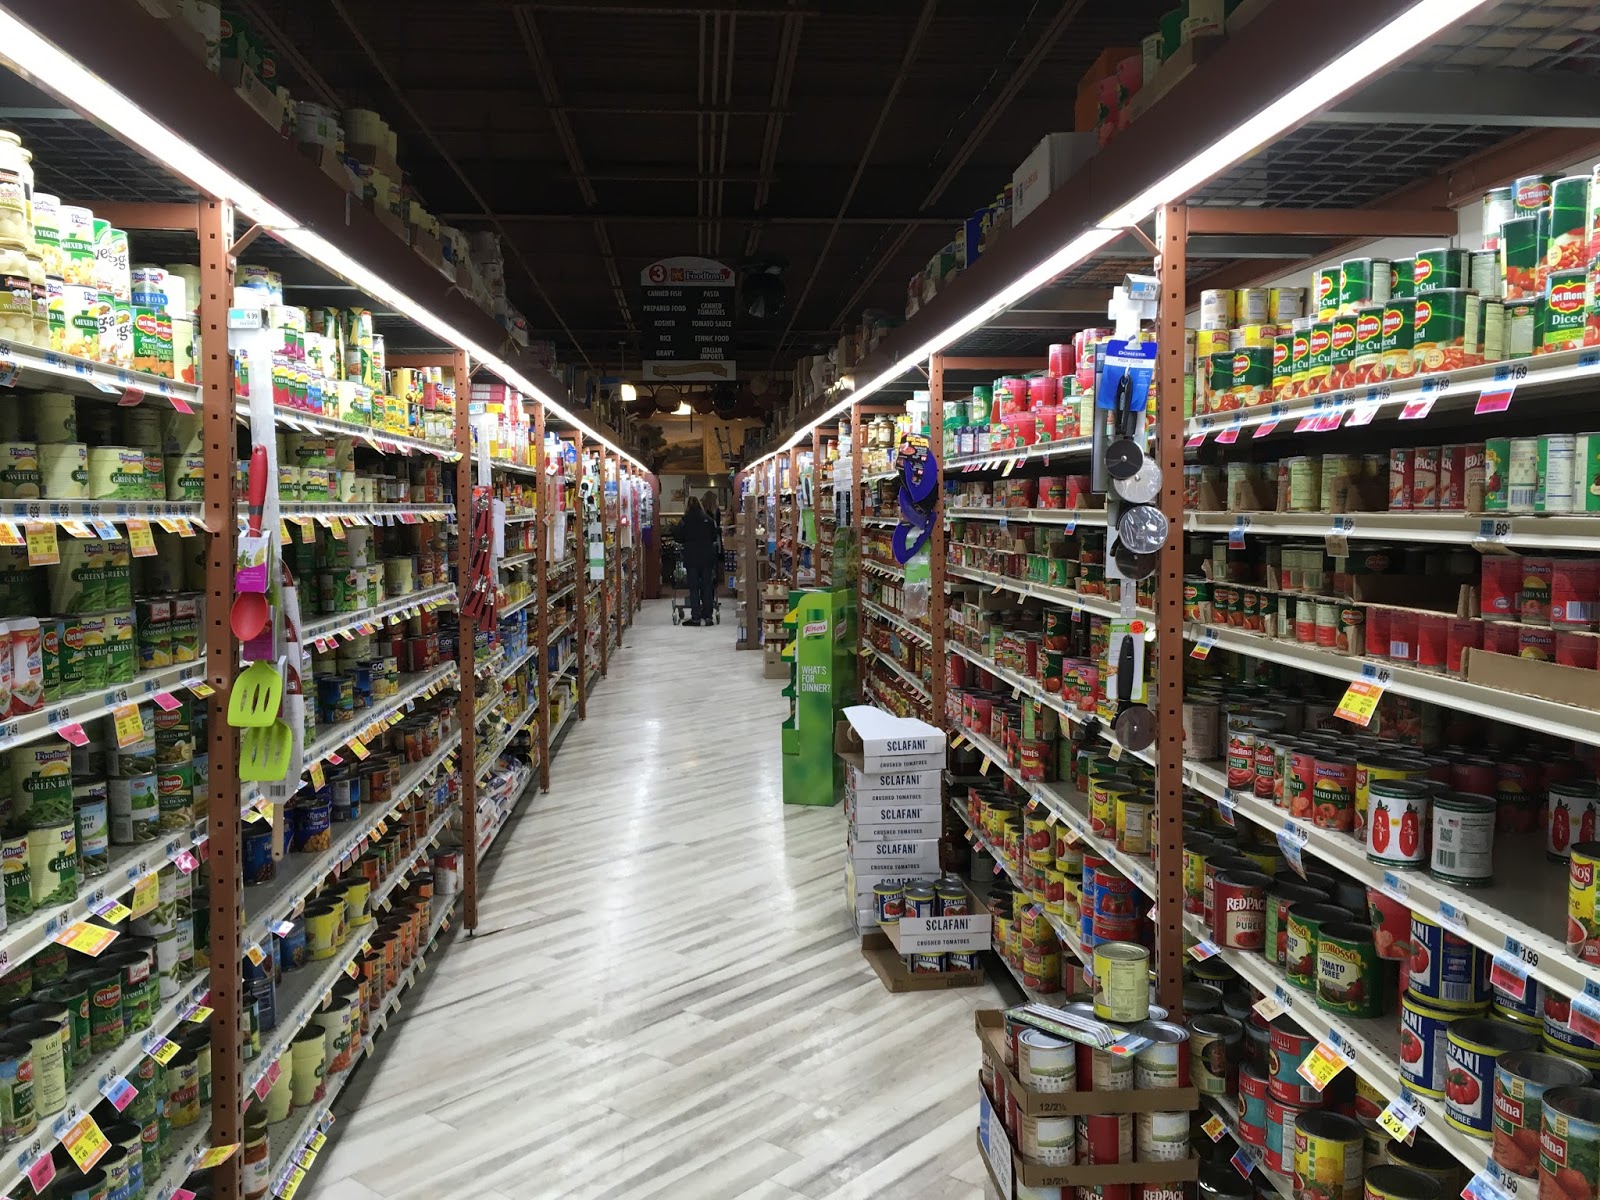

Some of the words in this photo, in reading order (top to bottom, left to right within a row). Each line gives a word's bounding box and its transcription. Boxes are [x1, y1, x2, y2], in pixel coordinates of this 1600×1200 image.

[652, 265, 664, 281] 3
[686, 269, 725, 280] Foodtown
[134, 295, 166, 303] ARROTS
[1552, 293, 1563, 303] Del
[74, 319, 93, 327] MIXED
[801, 666, 827, 675] WHAT'S
[801, 675, 815, 683] FOR
[801, 683, 831, 692] DINNER?
[887, 740, 926, 751] SCLAFANI
[1316, 767, 1345, 777] Foodtown
[880, 775, 920, 786] SCLAFANI
[28, 781, 55, 791] GREEN
[880, 808, 920, 820] SCLAFANI
[876, 844, 916, 855] SCLAFANI
[926, 919, 969, 931] SCLAFANI
[1236, 921, 1261, 930] PUREE
[1319, 957, 1345, 974] TOMATO
[1322, 967, 1340, 980] PUREE
[1450, 1110, 1472, 1125] PUREE
